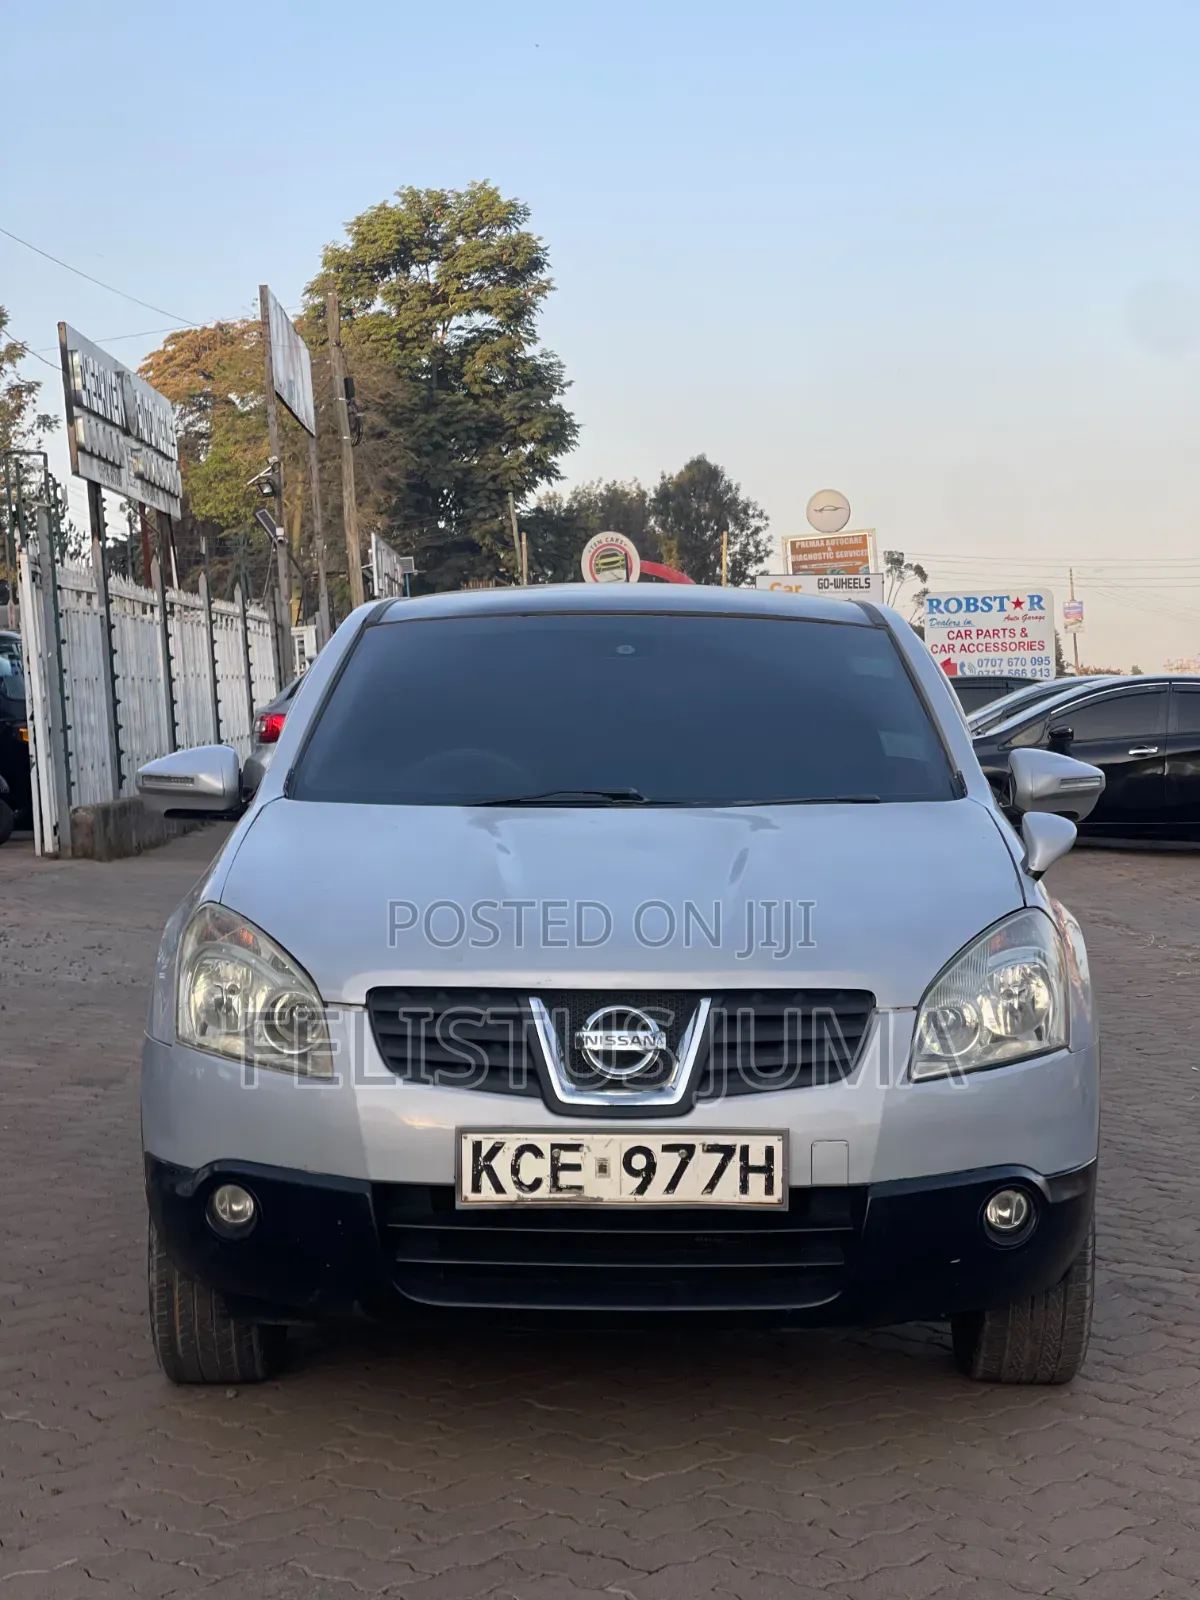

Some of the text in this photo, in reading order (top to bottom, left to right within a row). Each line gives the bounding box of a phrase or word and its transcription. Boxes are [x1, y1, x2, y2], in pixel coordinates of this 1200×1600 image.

[605, 537, 624, 545] CARS
[796, 536, 863, 549] PREMAX AUTOCARE
[791, 552, 834, 562] DIAGNOSTIC
[817, 577, 871, 590] GO-WHEELS
[929, 618, 961, 627] Dealers
[1021, 613, 1046, 623] Garage
[947, 627, 1029, 641] CAR PARTS &
[930, 640, 1045, 655] CAR ACCESSORIES
[977, 656, 1051, 668] 0707 670 095
[1031, 667, 1051, 678] 913
[585, 1035, 656, 1047] NISSAN
[470, 1140, 775, 1197] KCE 977H
